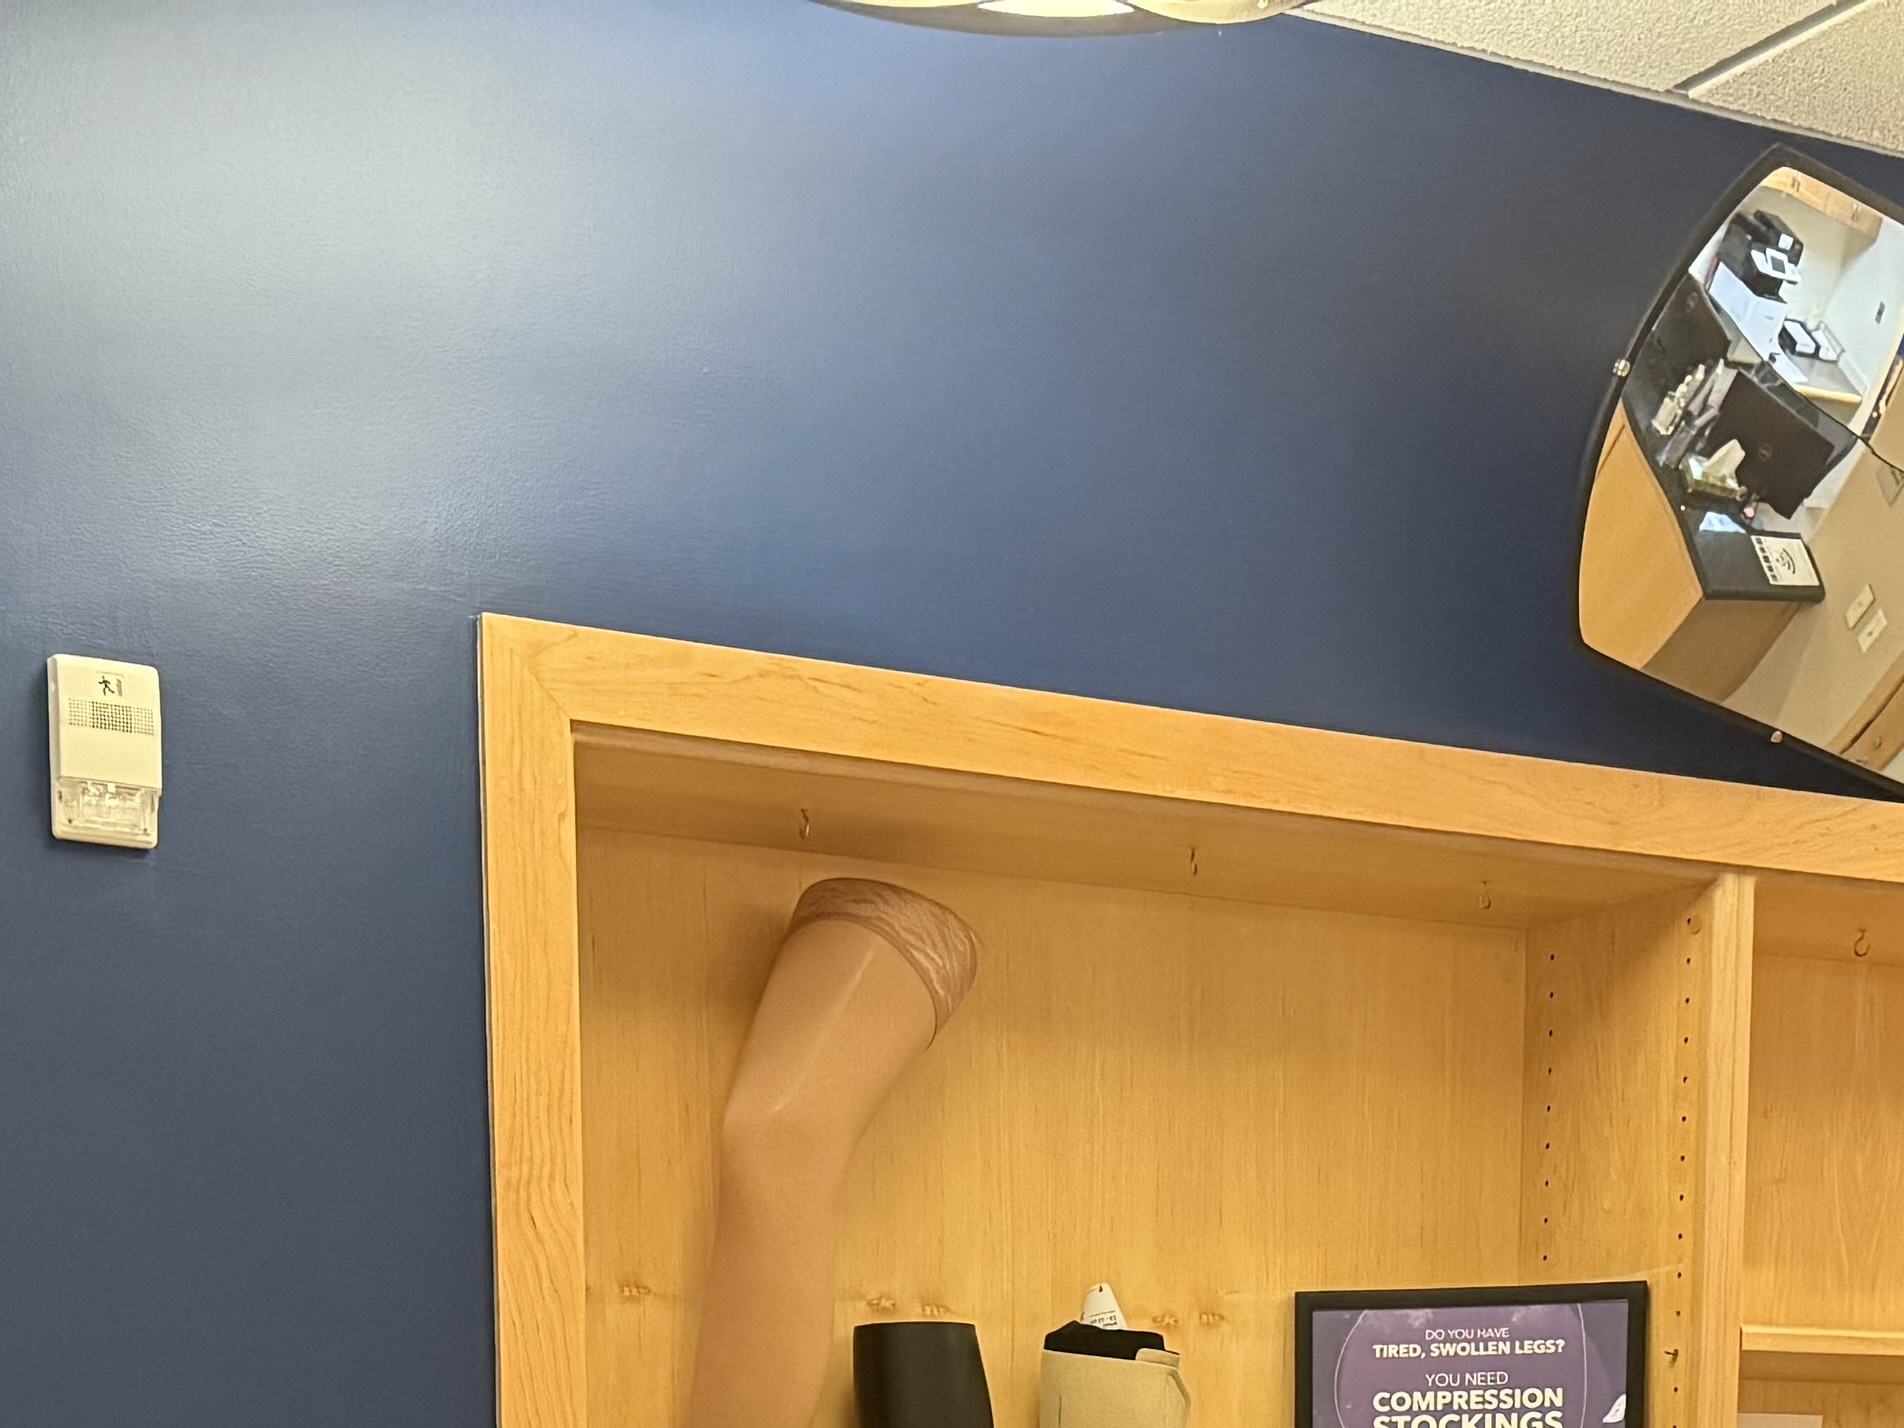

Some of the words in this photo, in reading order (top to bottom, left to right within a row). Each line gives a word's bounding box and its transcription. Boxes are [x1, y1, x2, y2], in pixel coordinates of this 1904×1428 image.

[1425, 1328, 1445, 1341] DO
[1448, 1327, 1474, 1340] YOU
[1477, 1327, 1510, 1339] HAVE
[1372, 1343, 1426, 1359] TIRED,
[1430, 1341, 1511, 1357] SWOLLEN
[1514, 1339, 1566, 1355] LEGS?
[1425, 1373, 1461, 1387] YOU
[1464, 1371, 1509, 1386] NEED
[1372, 1387, 1564, 1413] COMPRESSION
